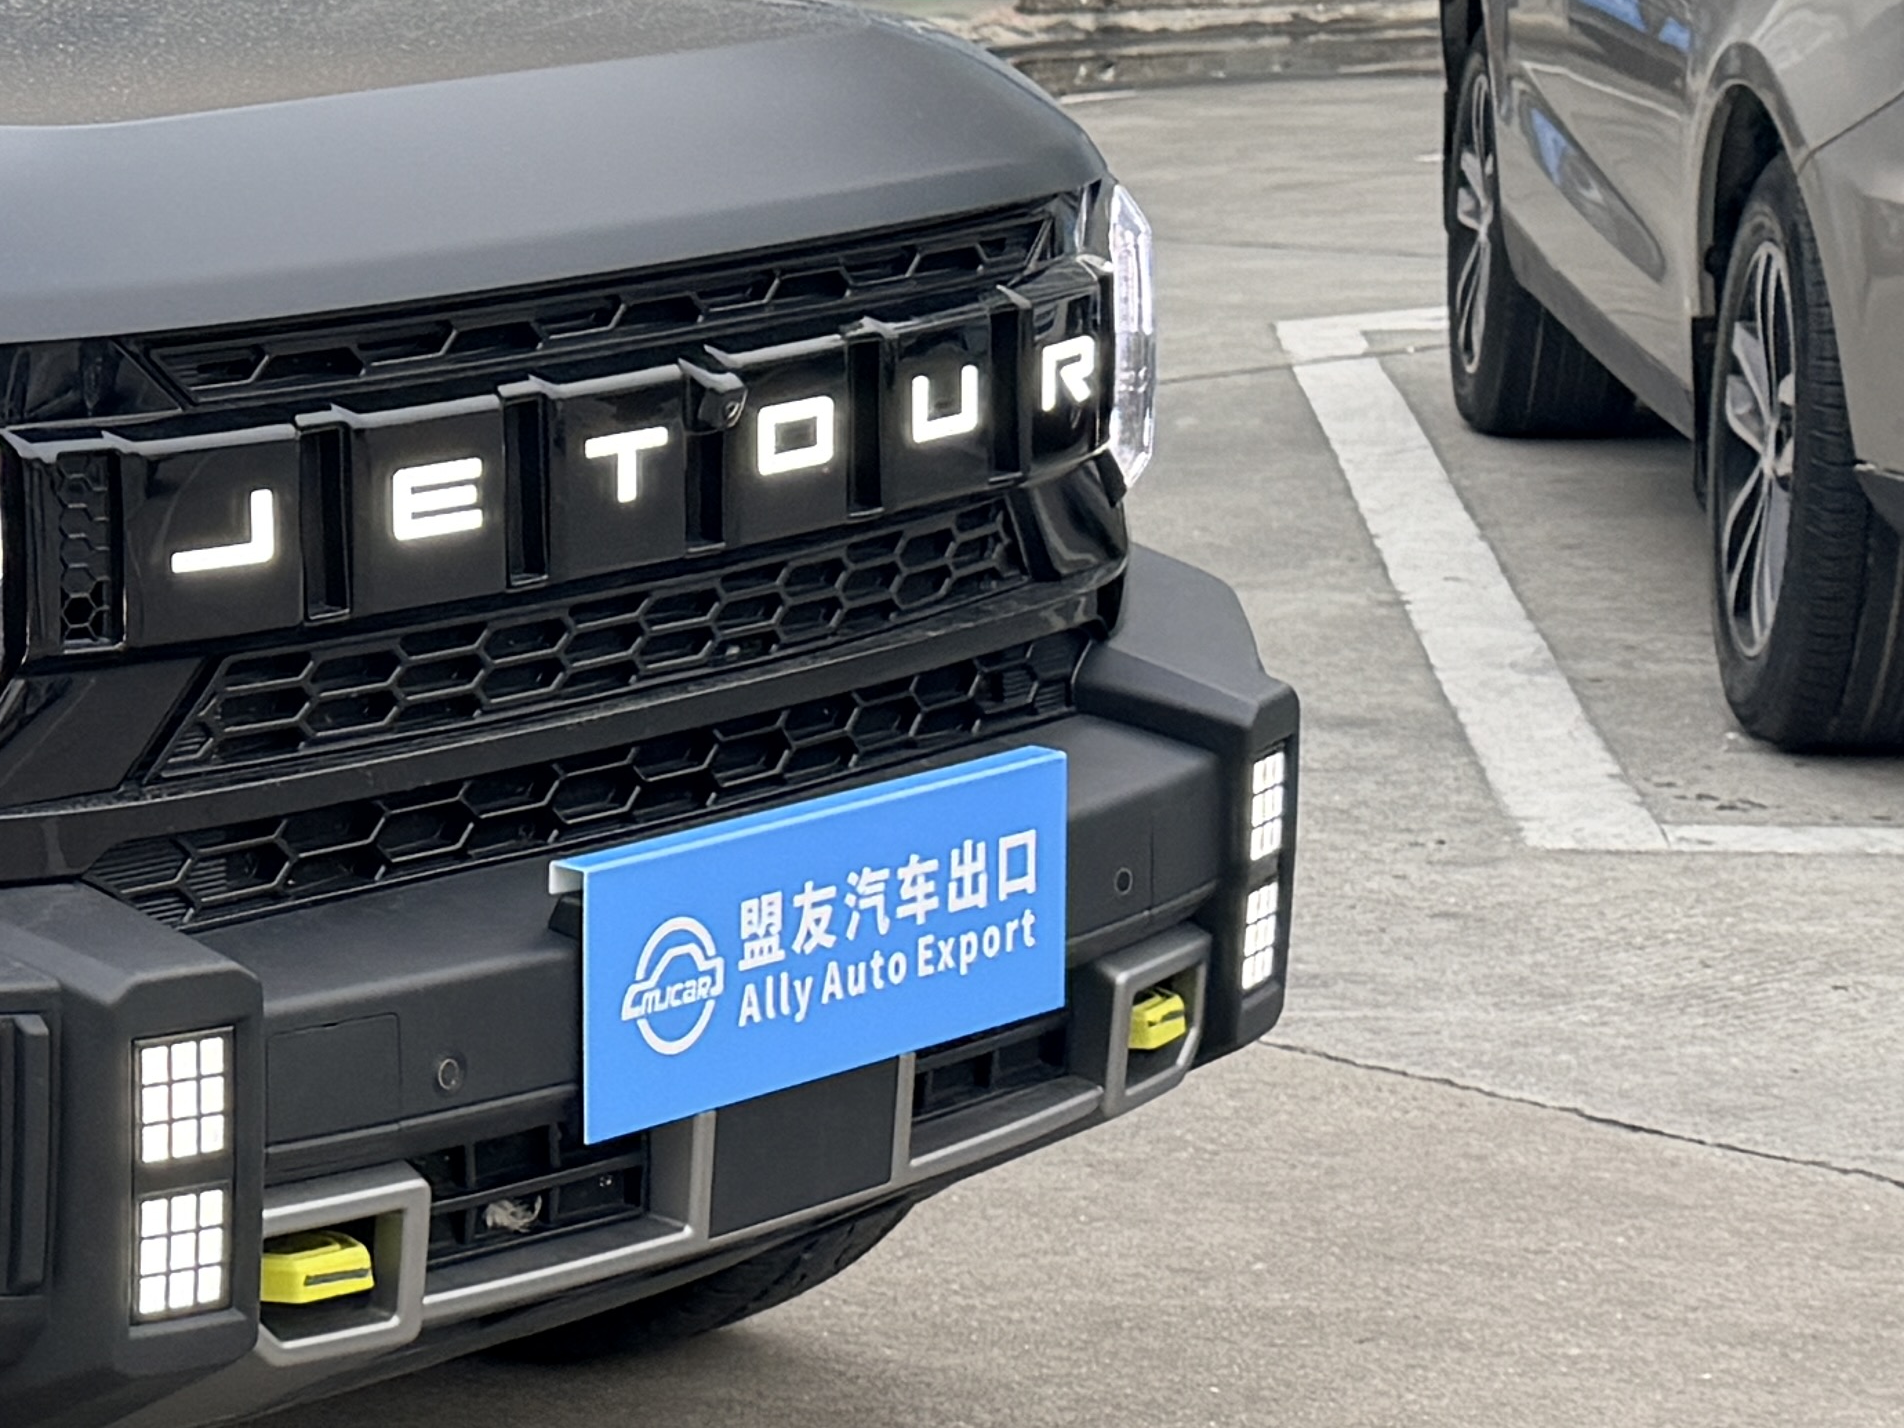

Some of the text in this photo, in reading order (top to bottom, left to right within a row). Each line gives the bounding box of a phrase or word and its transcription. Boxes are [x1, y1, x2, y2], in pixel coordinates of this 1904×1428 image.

[168, 332, 1097, 576] JETOUR
[738, 828, 1037, 969] 盟友汽车出口
[738, 909, 1037, 1027] Ally Auto Export
